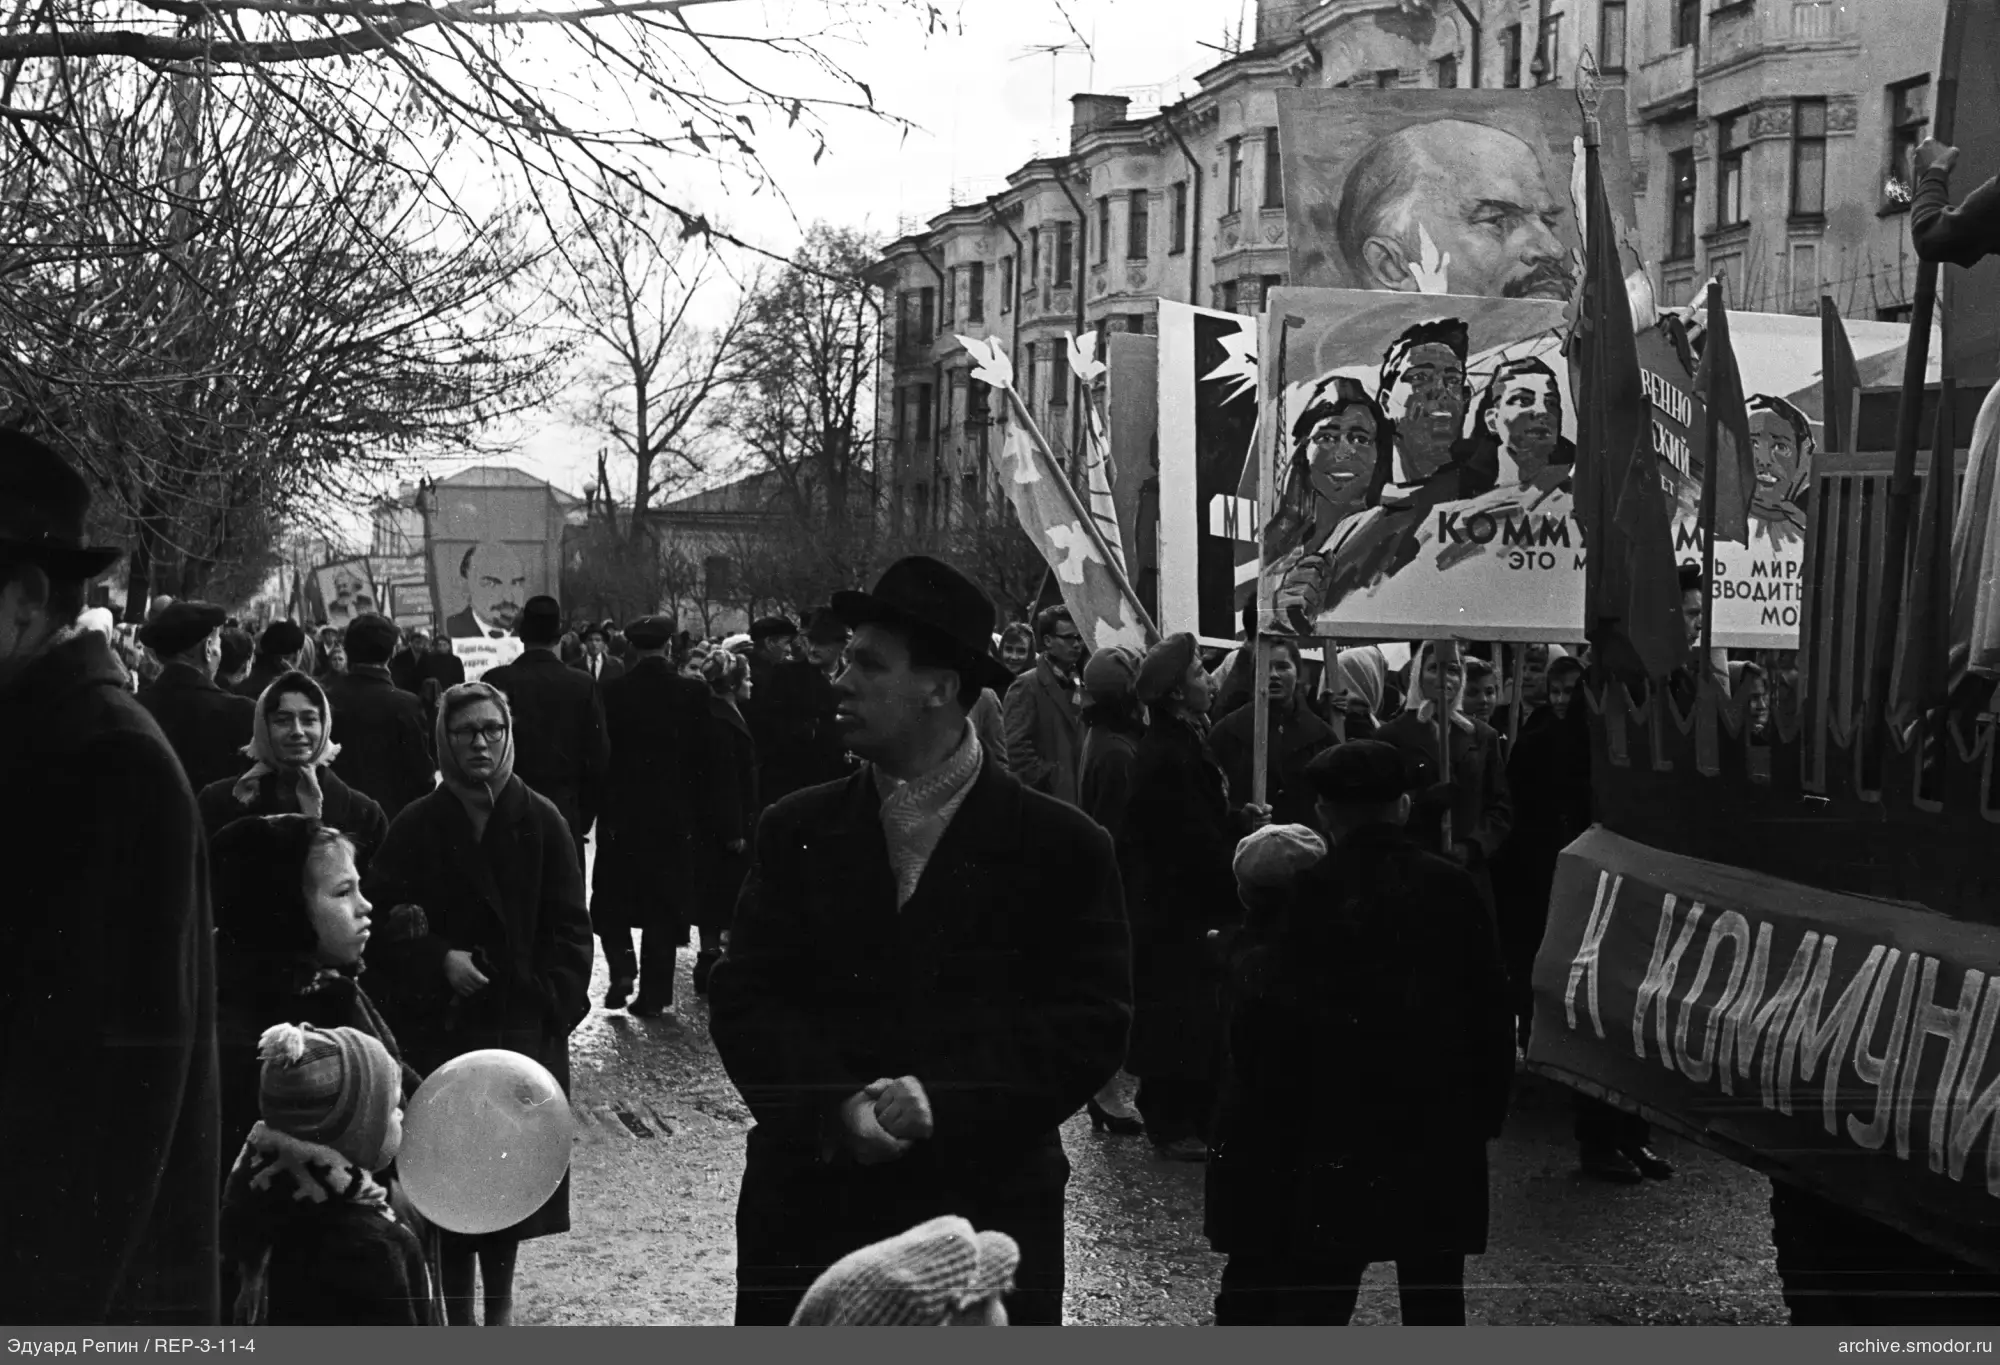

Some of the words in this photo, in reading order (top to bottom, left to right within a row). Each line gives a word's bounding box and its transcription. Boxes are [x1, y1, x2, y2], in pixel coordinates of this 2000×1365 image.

[1640, 367, 1692, 428] ВЕННО
[1652, 418, 1691, 479] СКИЙ
[1660, 474, 1675, 497] ЕТ
[1508, 551, 1556, 570] ЭТО
[1565, 870, 1623, 1038] К
[1632, 892, 2000, 1198] КОММУНИ
